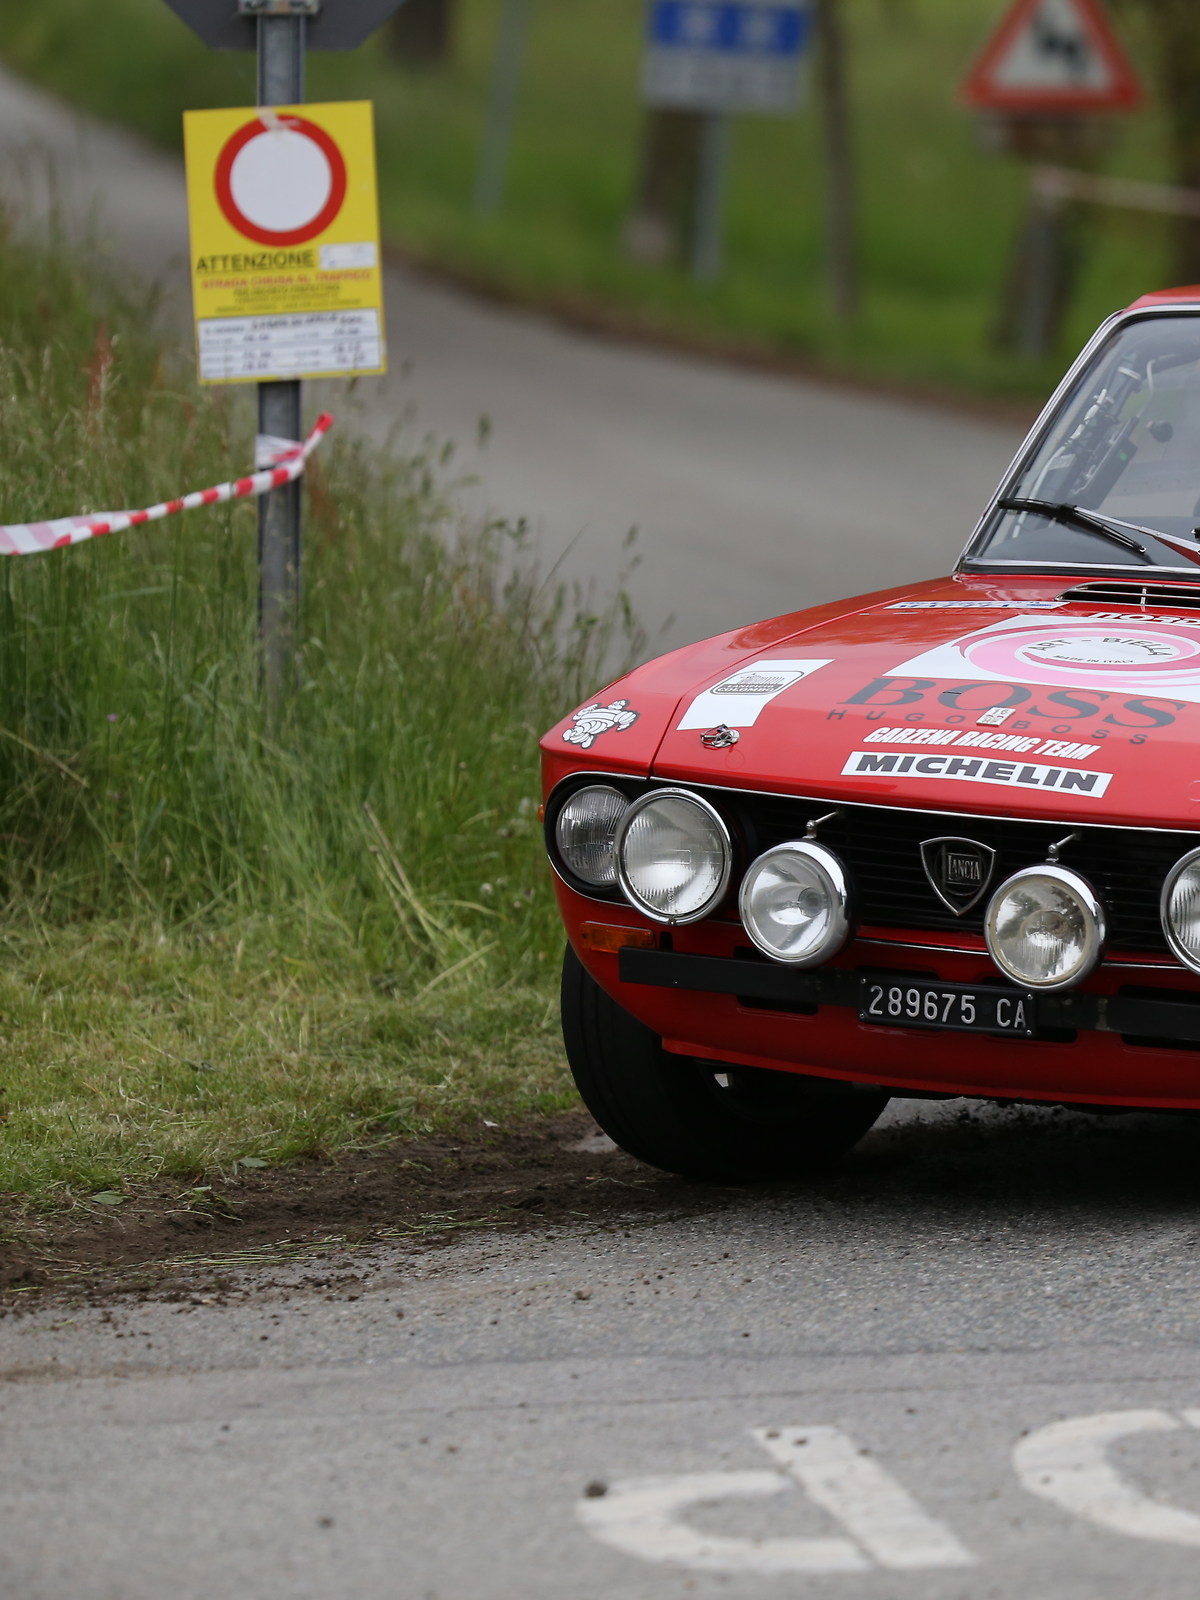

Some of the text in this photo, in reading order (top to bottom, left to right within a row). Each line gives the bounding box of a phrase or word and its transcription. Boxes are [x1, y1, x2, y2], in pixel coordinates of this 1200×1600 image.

[197, 250, 315, 271] ATTENZIONE
[836, 676, 1188, 729] BOSS
[827, 708, 1148, 746] HUGO BOSS
[863, 727, 1102, 760] GARZENA RACING TEAM
[856, 753, 1100, 794] MICHELIN
[947, 853, 981, 881] LANCIA
[868, 985, 1027, 1028] 289675 CA
